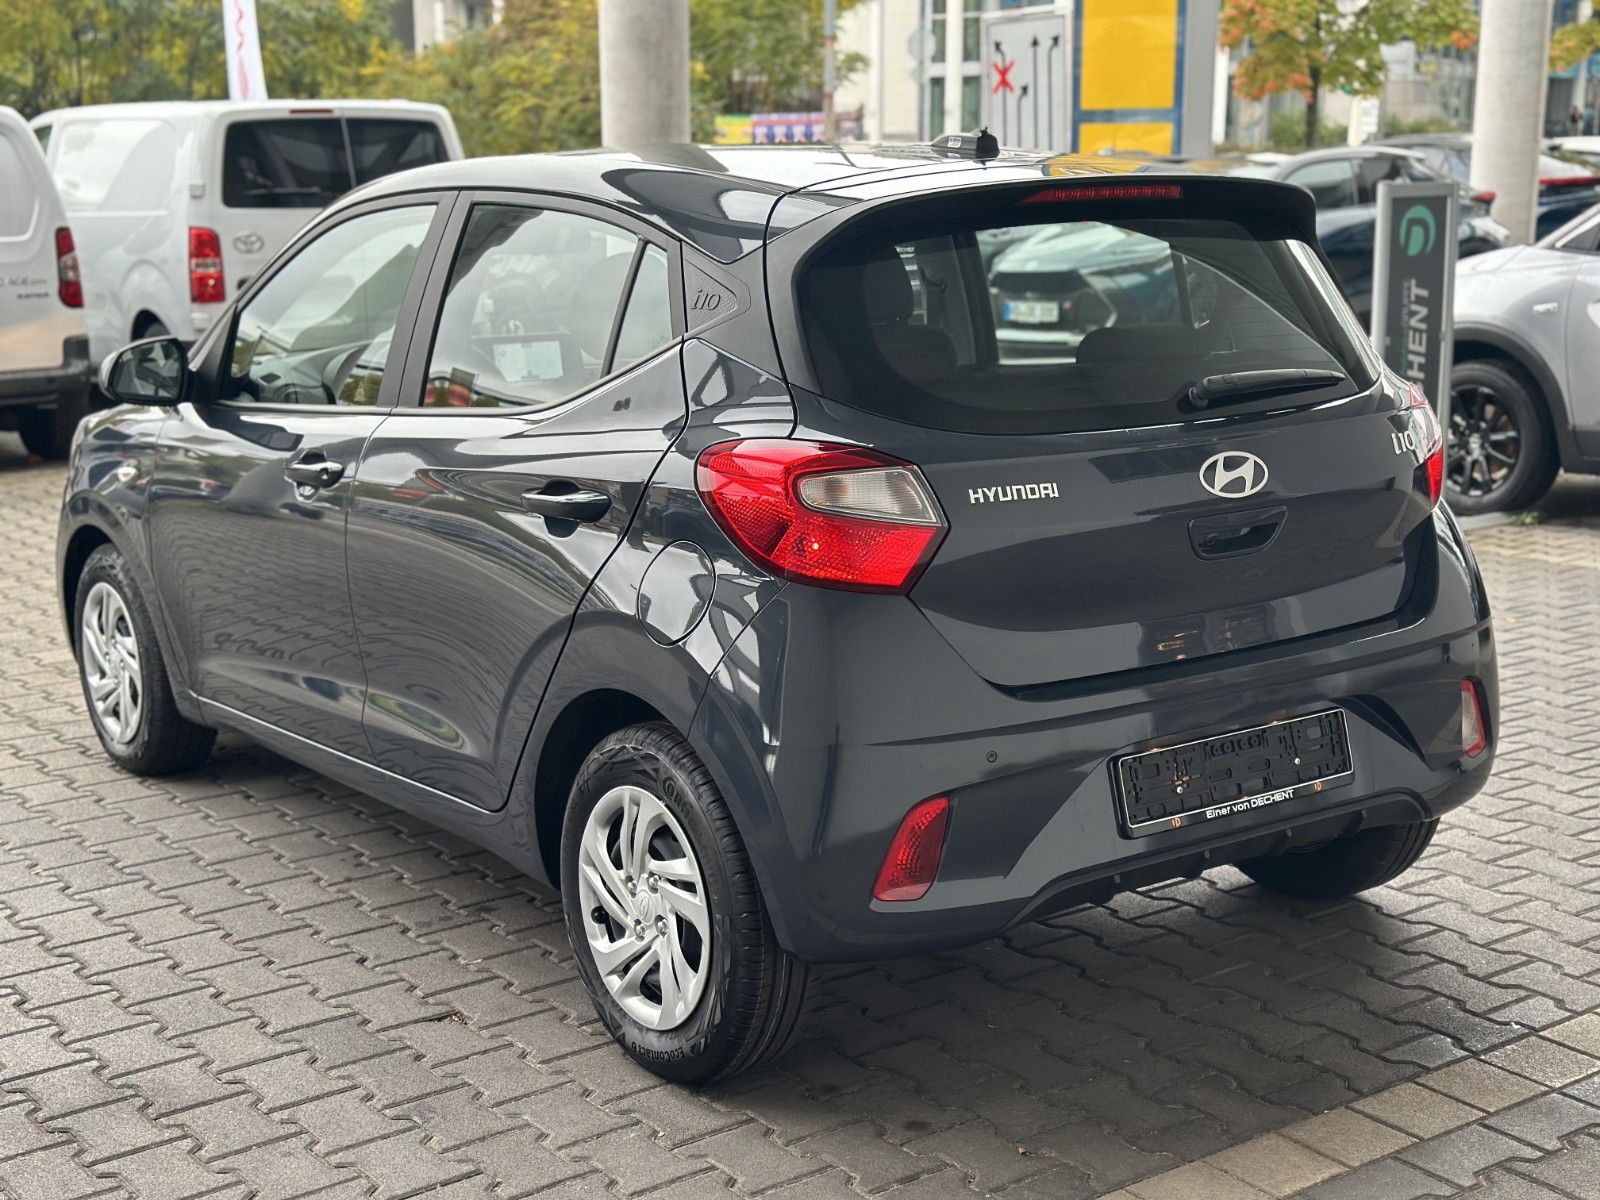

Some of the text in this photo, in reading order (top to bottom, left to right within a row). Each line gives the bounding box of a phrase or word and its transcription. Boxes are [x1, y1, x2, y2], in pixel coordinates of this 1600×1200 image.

[1405, 278, 1429, 389] HENT
[1391, 430, 1416, 455] i10
[968, 482, 1059, 504] HYUNDAI
[1232, 802, 1250, 813] von
[1250, 789, 1295, 808] DECHENT
